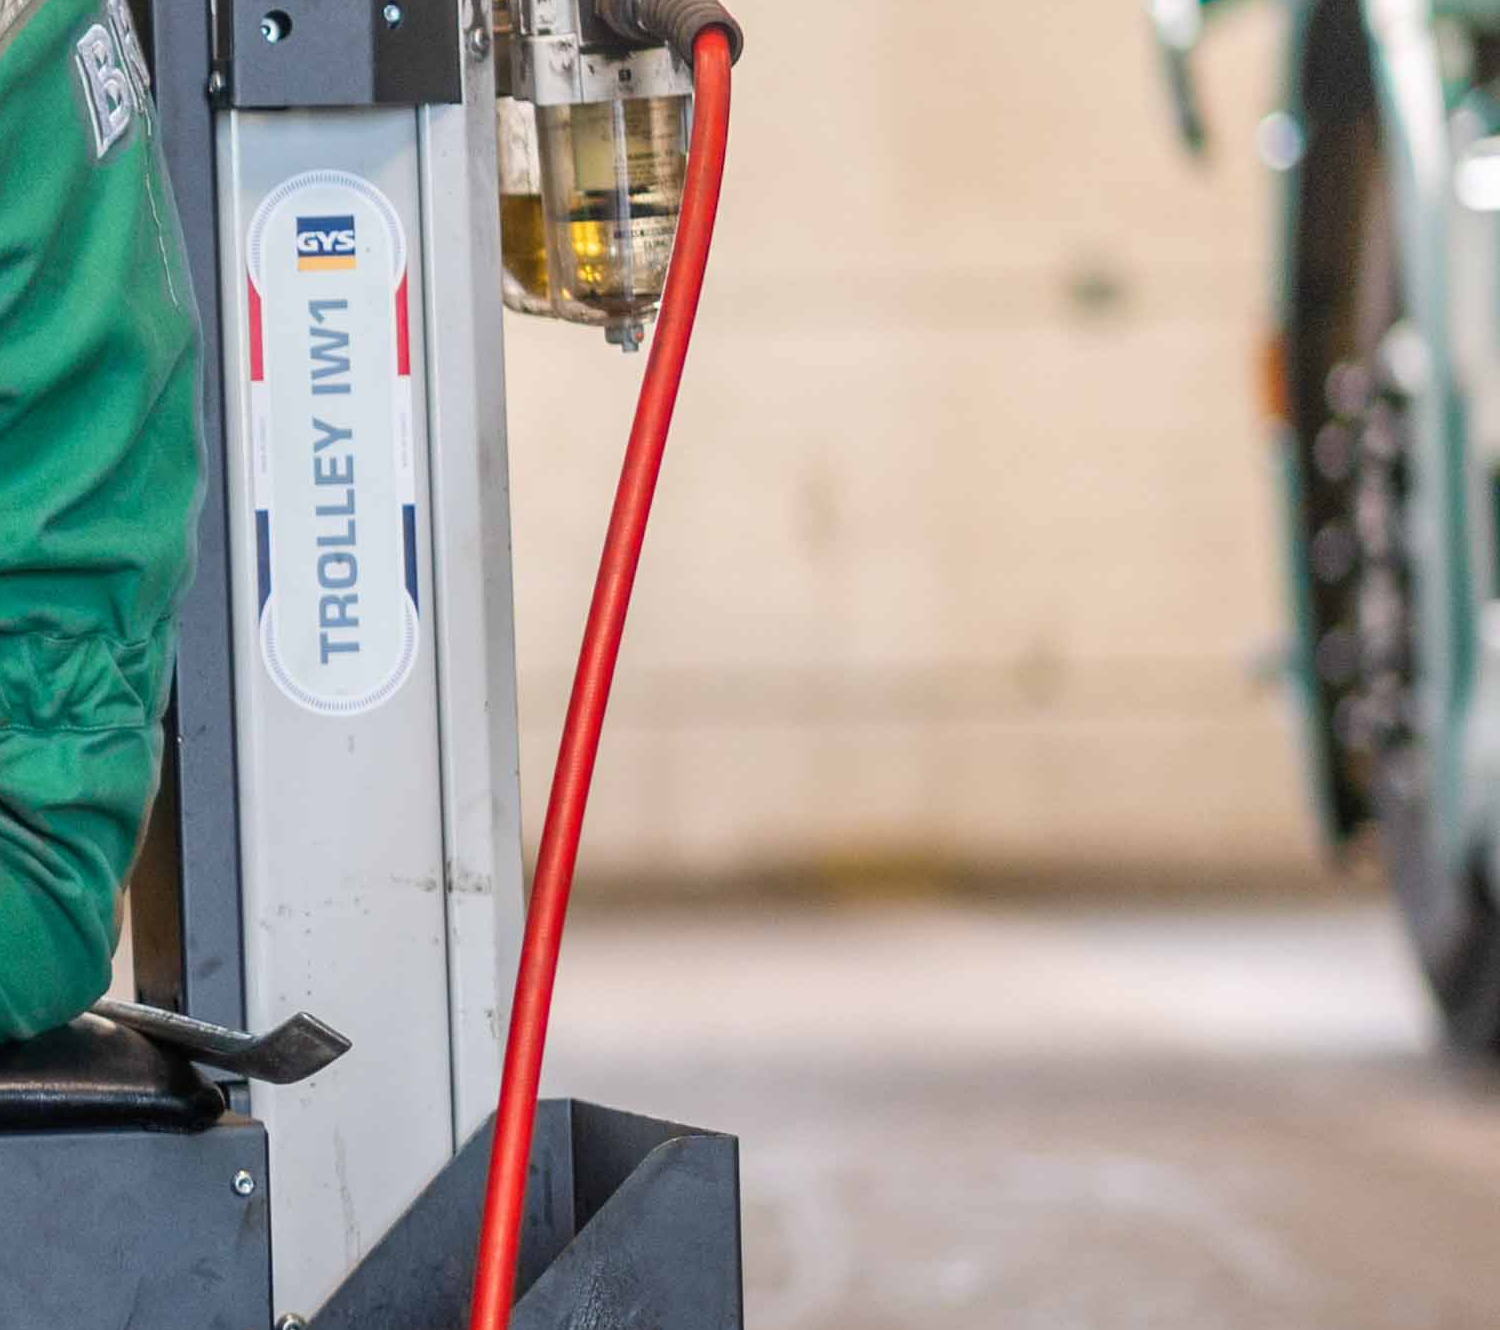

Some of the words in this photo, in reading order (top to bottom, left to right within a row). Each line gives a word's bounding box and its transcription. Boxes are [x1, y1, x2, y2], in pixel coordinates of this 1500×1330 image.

[296, 229, 356, 256] GYS
[310, 298, 352, 396] IW1
[312, 413, 361, 666] TROLLEY
